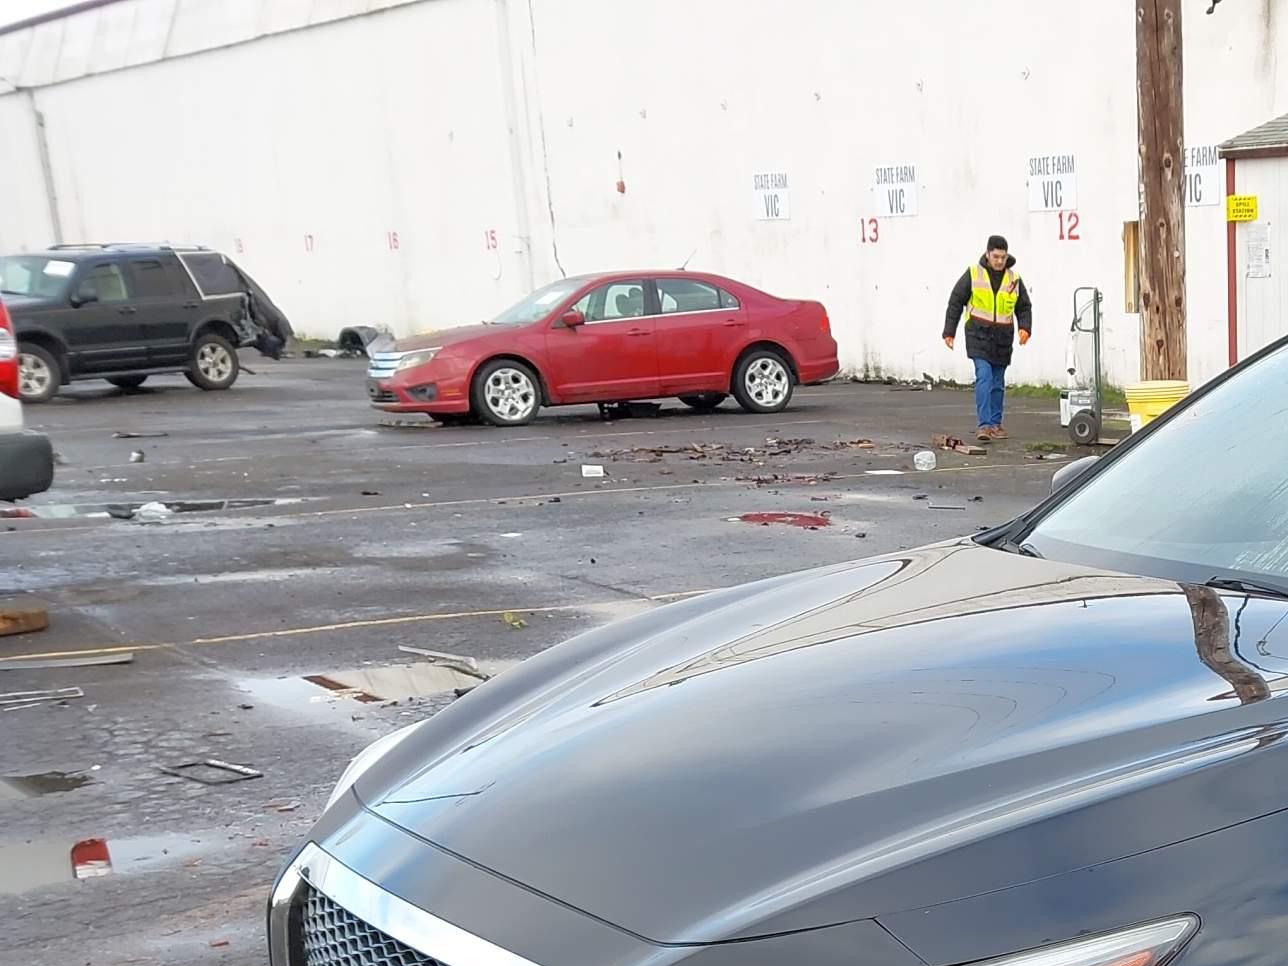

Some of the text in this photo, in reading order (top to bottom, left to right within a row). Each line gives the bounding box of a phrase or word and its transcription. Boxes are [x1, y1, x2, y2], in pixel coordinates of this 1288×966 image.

[1029, 154, 1076, 177] STATE FARM
[1191, 146, 1218, 168] FARM
[754, 173, 788, 190] STATE FARM
[876, 165, 915, 185] STATE FARM
[764, 194, 780, 217] VIC
[888, 188, 905, 214] VIC
[1042, 180, 1063, 209] VIC
[861, 217, 879, 243] 13
[1058, 210, 1080, 240] 12
[485, 230, 498, 250] 15
